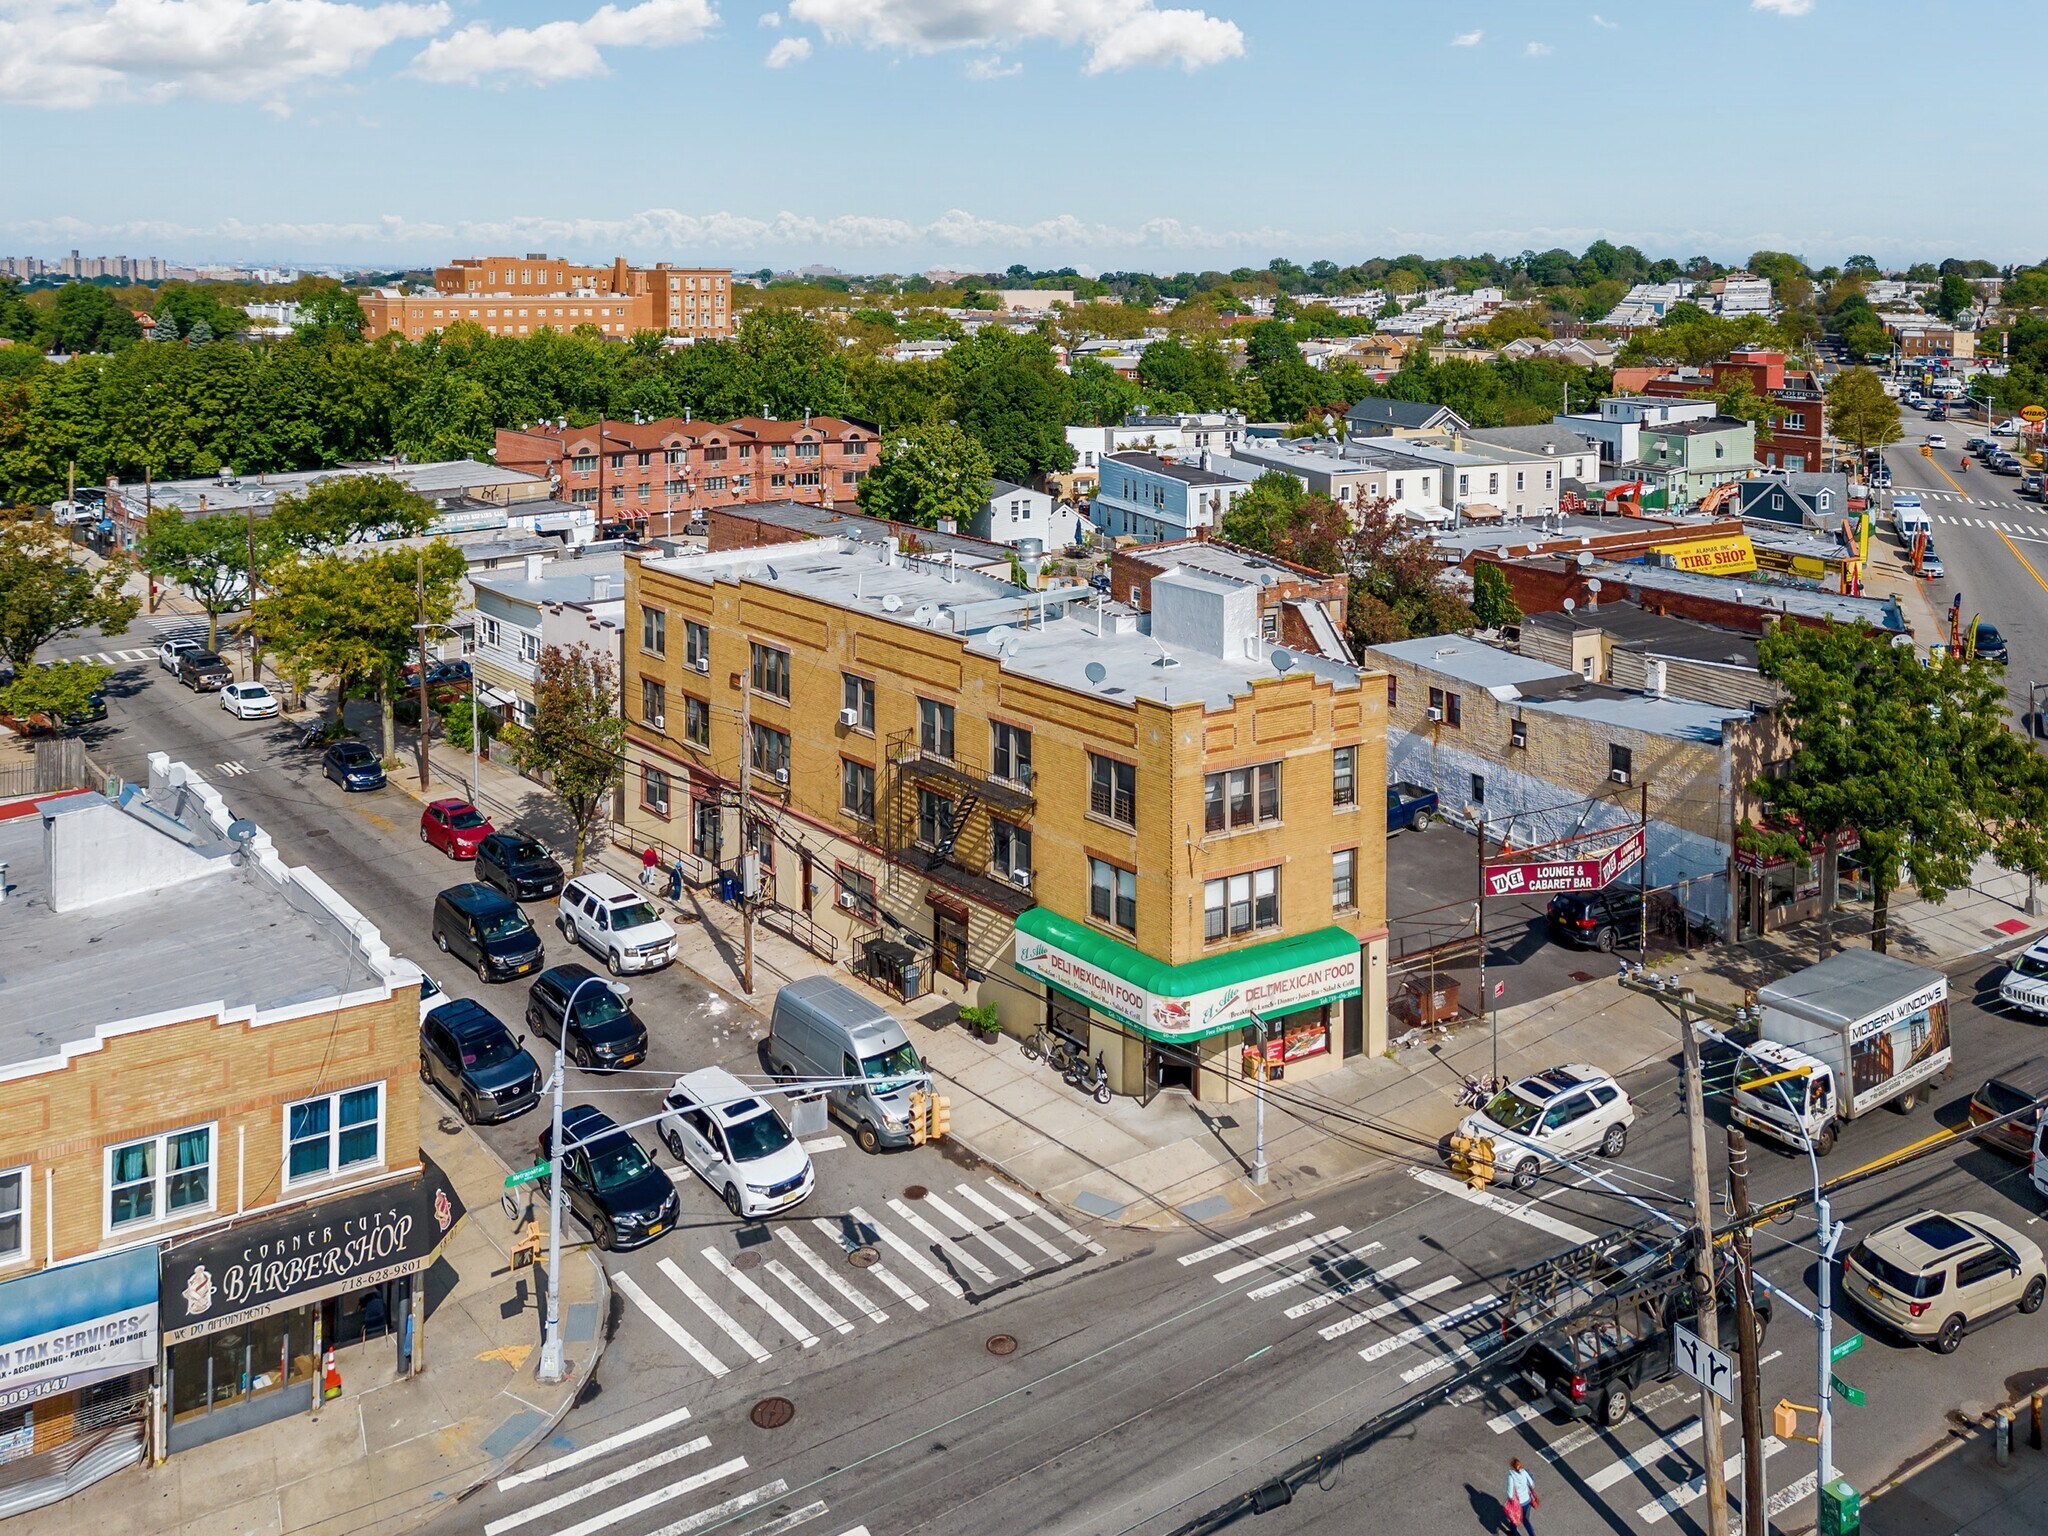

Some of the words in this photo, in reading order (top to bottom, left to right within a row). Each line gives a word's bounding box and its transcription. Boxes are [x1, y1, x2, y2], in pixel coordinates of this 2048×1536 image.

[1681, 553, 1712, 569] TIRE
[1714, 549, 1747, 564] SHOP
[1490, 868, 1525, 894] VIXEN
[1529, 878, 1573, 891] CABARET
[1573, 877, 1592, 889] BAR
[1537, 865, 1575, 878] LOUNGE
[1577, 865, 1584, 876] &
[1051, 954, 1071, 975] DELI
[1072, 964, 1114, 996] MEXICAN
[1116, 985, 1144, 1010] FOOD
[1273, 970, 1322, 994] MEXICAN
[1324, 962, 1355, 981] FOOD
[1852, 1009, 1895, 1040] MODERN
[1896, 986, 1942, 1018] WINDOWS
[512, 1166, 545, 1181] Metropolitan
[243, 1227, 332, 1262] CORNER
[344, 1208, 397, 1236] CUTS
[223, 1214, 413, 1304] BARBERSHOP
[341, 1259, 422, 1293] 718-628-9801
[173, 1329, 186, 1340] WE
[190, 1323, 204, 1336] DO
[207, 1303, 271, 1331] APPOINTMENTS
[13, 1354, 63, 1375] ACCOUNTING
[70, 1343, 101, 1359] PAYROLL
[109, 1335, 125, 1348] AND
[126, 1329, 148, 1343] MORE
[15, 1341, 49, 1366] TAX
[53, 1315, 140, 1354] SERVICES
